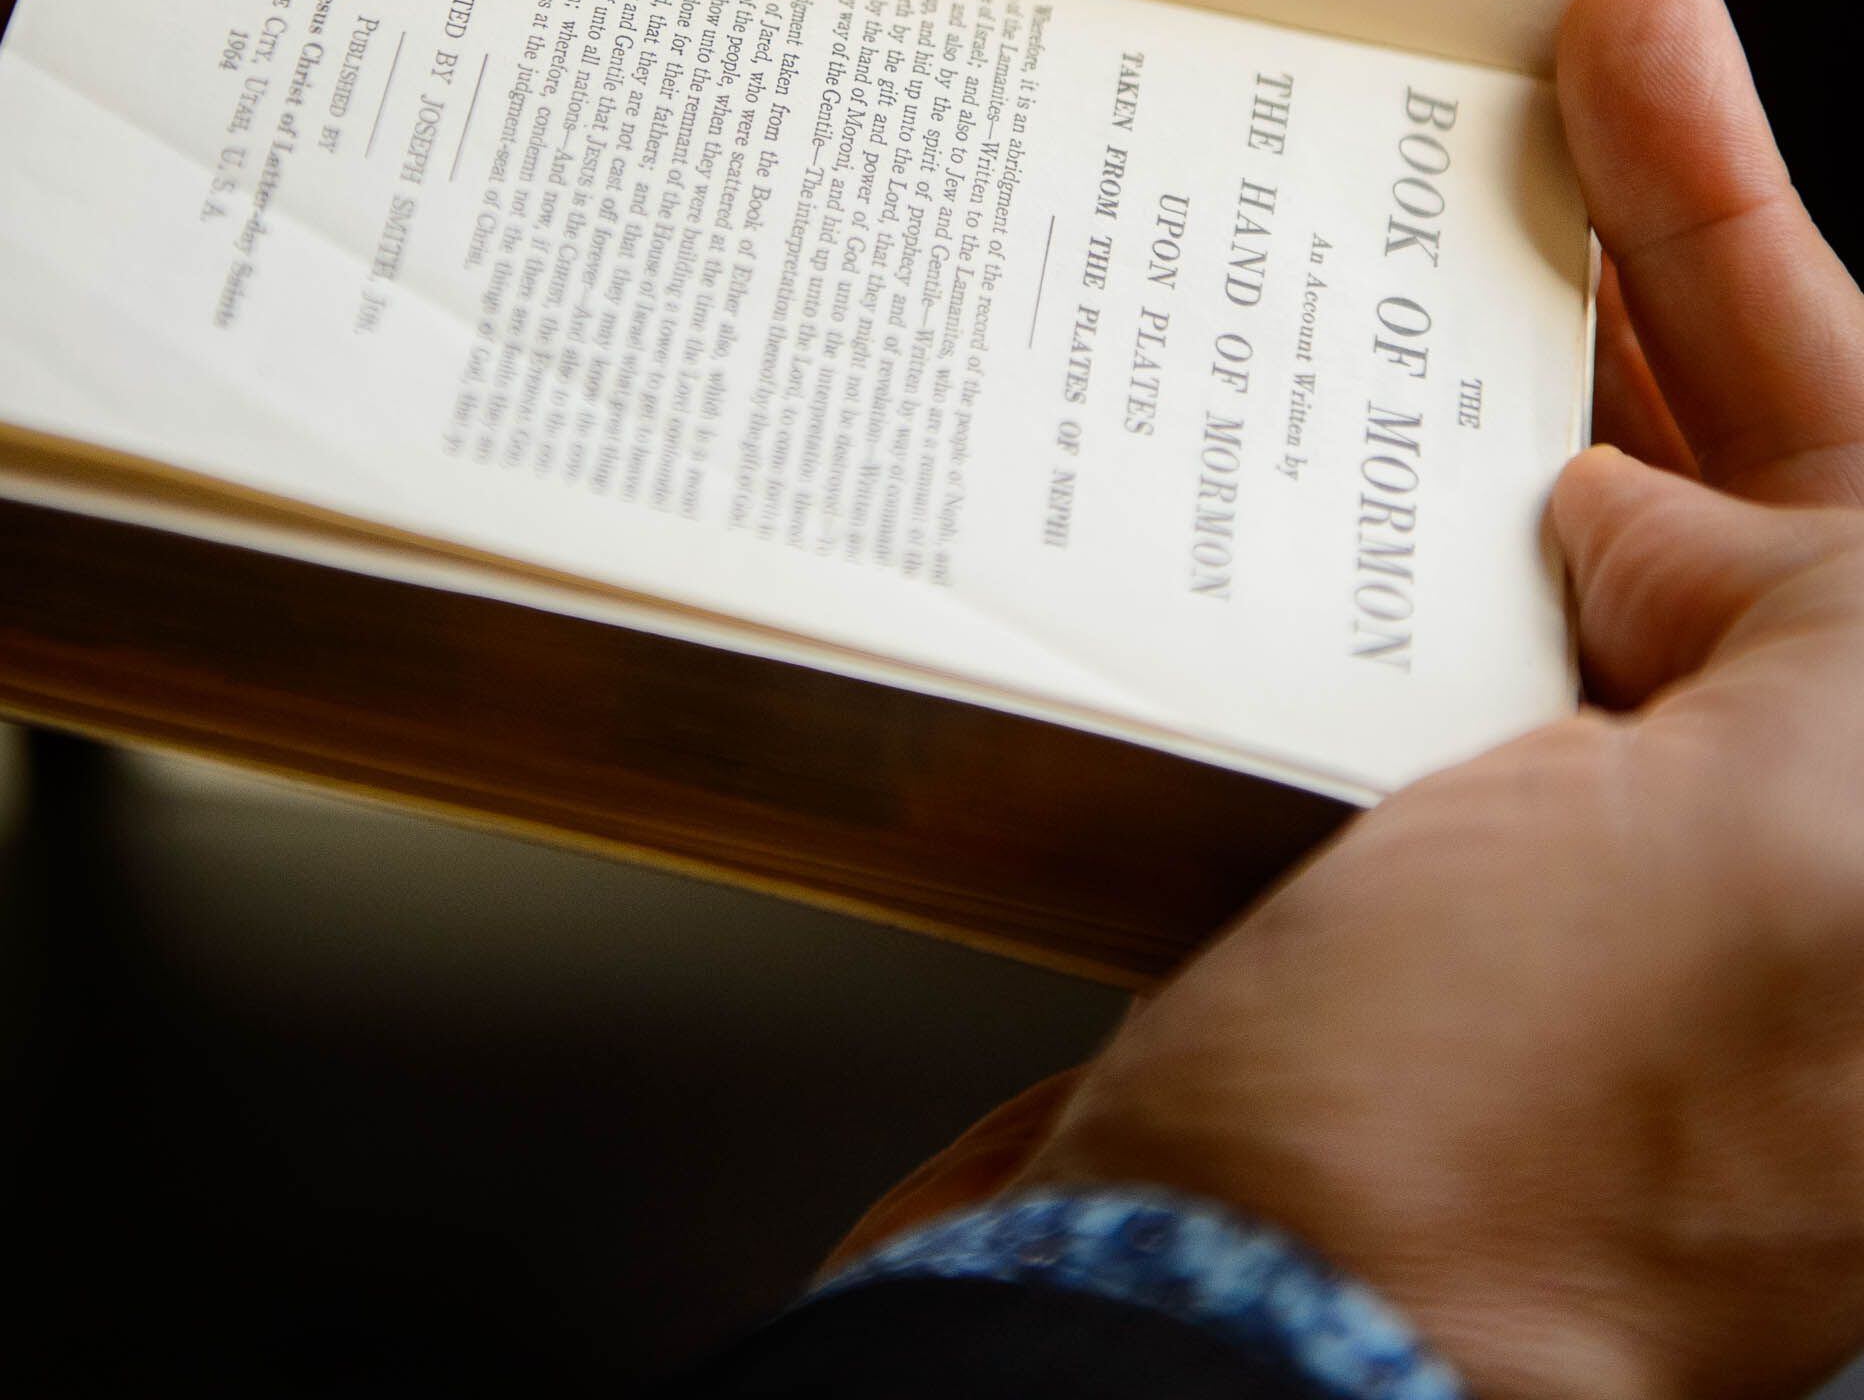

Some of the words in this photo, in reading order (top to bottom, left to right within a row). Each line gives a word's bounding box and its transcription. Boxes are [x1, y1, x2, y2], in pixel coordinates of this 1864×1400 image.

[532, 13, 549, 29] at
[588, 6, 608, 40] unto
[619, 3, 637, 32] and
[732, 10, 754, 33] the
[765, 3, 783, 20] of
[832, 12, 853, 41] way
[643, 14, 667, 44] that
[670, 33, 692, 56] for
[750, 19, 780, 64] Jared,
[862, 20, 883, 43] the
[887, 24, 911, 44] by
[917, 20, 936, 48] and
[219, 29, 249, 70] 1964
[524, 35, 546, 60] the
[581, 44, 601, 66] all
[603, 35, 634, 91] Gentile
[697, 29, 716, 64] unto
[716, 35, 743, 87] people,
[831, 42, 850, 61] of
[884, 49, 905, 73] the
[912, 50, 934, 76] hid
[943, 33, 963, 62] also
[286, 42, 324, 105] Christ
[431, 49, 459, 85] BY
[631, 51, 658, 86] they
[659, 62, 684, 100] their
[689, 67, 712, 92] the
[775, 53, 800, 95] taken
[825, 61, 847, 86] the
[854, 46, 879, 85] hand
[934, 68, 959, 89] by
[745, 72, 767, 103] who
[850, 87, 868, 107] of
[877, 78, 897, 106] gift
[904, 79, 923, 100] up
[962, 76, 980, 107] and
[1020, 78, 1040, 92] it
[1112, 53, 1144, 131] TAKEN
[592, 96, 617, 131] that
[625, 90, 643, 117] are
[708, 95, 732, 135] when
[930, 96, 952, 122] the
[1016, 96, 1037, 110] is
[1248, 74, 1294, 155] THE
[277, 113, 297, 138] of
[401, 94, 444, 184] JOSEPH
[616, 122, 635, 151] not
[672, 95, 700, 164] remnant
[735, 110, 755, 146] were
[764, 103, 791, 141] from
[869, 113, 888, 146] and
[898, 104, 918, 142] unto
[955, 109, 977, 142] also
[1012, 113, 1027, 133] an
[832, 108, 866, 171] Moroni,
[920, 129, 940, 172] spirit
[950, 147, 968, 164] to
[606, 158, 625, 191] cast
[695, 142, 722, 174] they
[756, 150, 779, 178] the
[891, 147, 913, 174] the
[666, 169, 685, 189] of
[715, 151, 744, 230] scattered
[857, 150, 879, 204] power
[915, 181, 933, 202] of
[943, 167, 965, 202] Jew
[992, 138, 1025, 234] abridgment
[1095, 145, 1128, 219] FROM
[1385, 89, 1457, 265] BOOK
[744, 185, 772, 230] Book
[826, 178, 845, 212] and
[878, 178, 908, 223] Lord,
[851, 211, 869, 231] of
[935, 206, 953, 240] and
[965, 210, 983, 228] to
[898, 205, 924, 286] prophecy
[959, 234, 980, 261] the
[988, 240, 1006, 261] of
[1148, 194, 1190, 289] UPON
[1225, 179, 1277, 306] HAND
[1309, 232, 1333, 264] An
[981, 264, 1003, 291] the
[1083, 236, 1112, 290] THE
[1296, 273, 1327, 361] Account
[1065, 305, 1100, 403] PLATES
[1373, 297, 1431, 379] OF
[1124, 307, 1169, 435] PLATES
[1212, 334, 1253, 394] OF
[1287, 374, 1316, 446] Written
[1458, 379, 1483, 429] THE
[1057, 420, 1079, 456] OF
[1276, 454, 1308, 481] by
[1044, 472, 1075, 547] NEPHI
[1192, 413, 1243, 596] MORMON
[1354, 405, 1421, 665] MORMON
